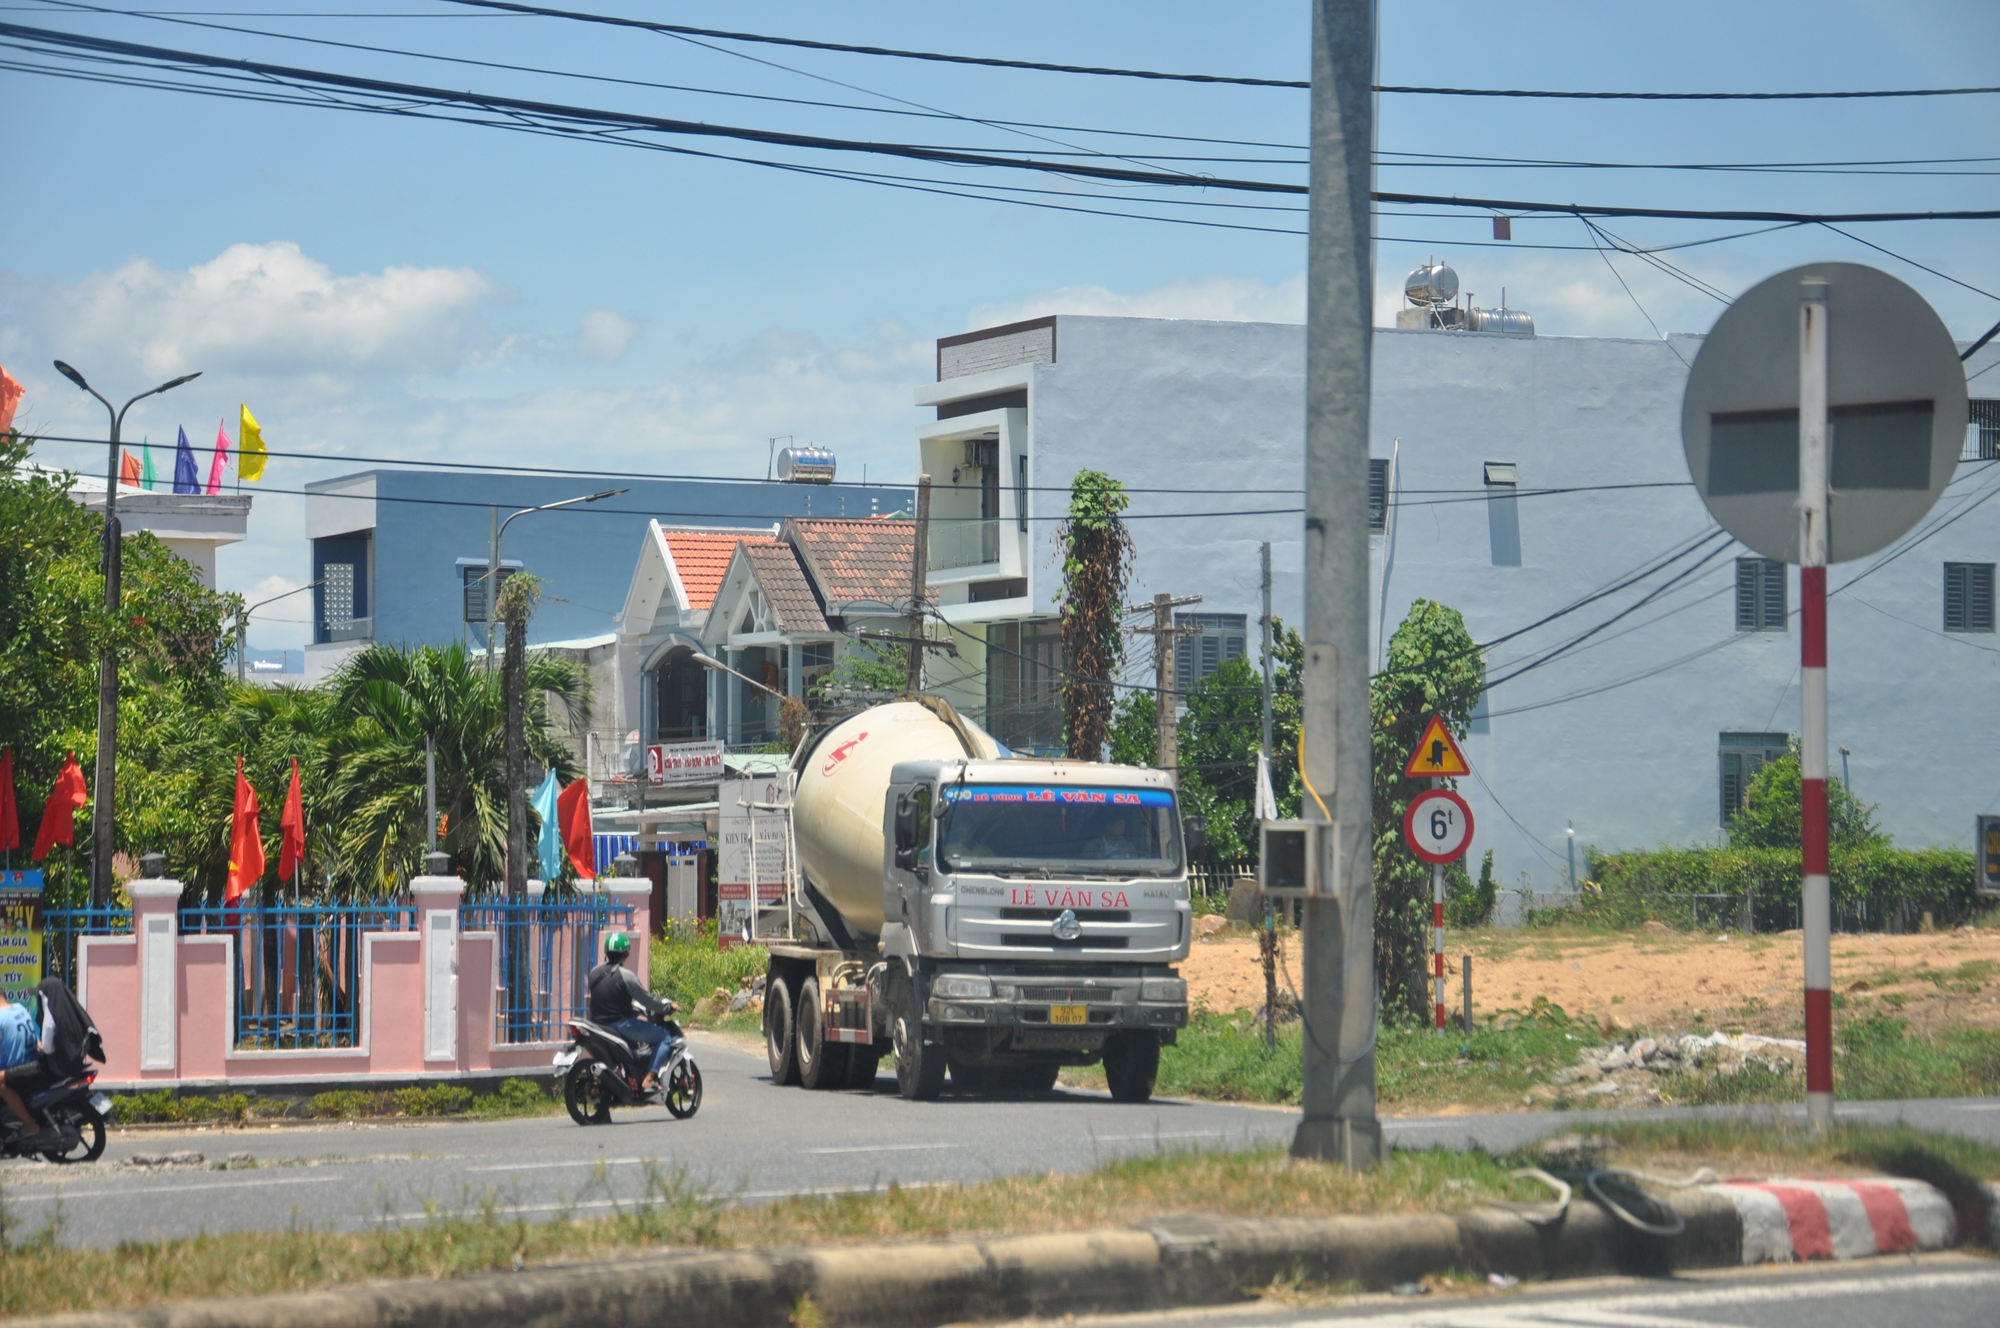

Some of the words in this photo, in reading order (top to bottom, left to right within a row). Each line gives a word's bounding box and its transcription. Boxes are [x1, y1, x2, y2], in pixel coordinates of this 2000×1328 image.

[1027, 789, 1055, 801] LÊ
[1062, 790, 1105, 802] VĂN
[1114, 794, 1141, 804] SA
[1431, 809, 1453, 840] 6t
[1011, 884, 1036, 906] LÊ
[1044, 886, 1092, 908] VĂN
[1101, 891, 1130, 908] SA
[12, 937, 28, 947] GIA
[7, 951, 38, 965] CHỐNG
[4, 970, 22, 982] TÚY
[1061, 1004, 1076, 1015] 92C
